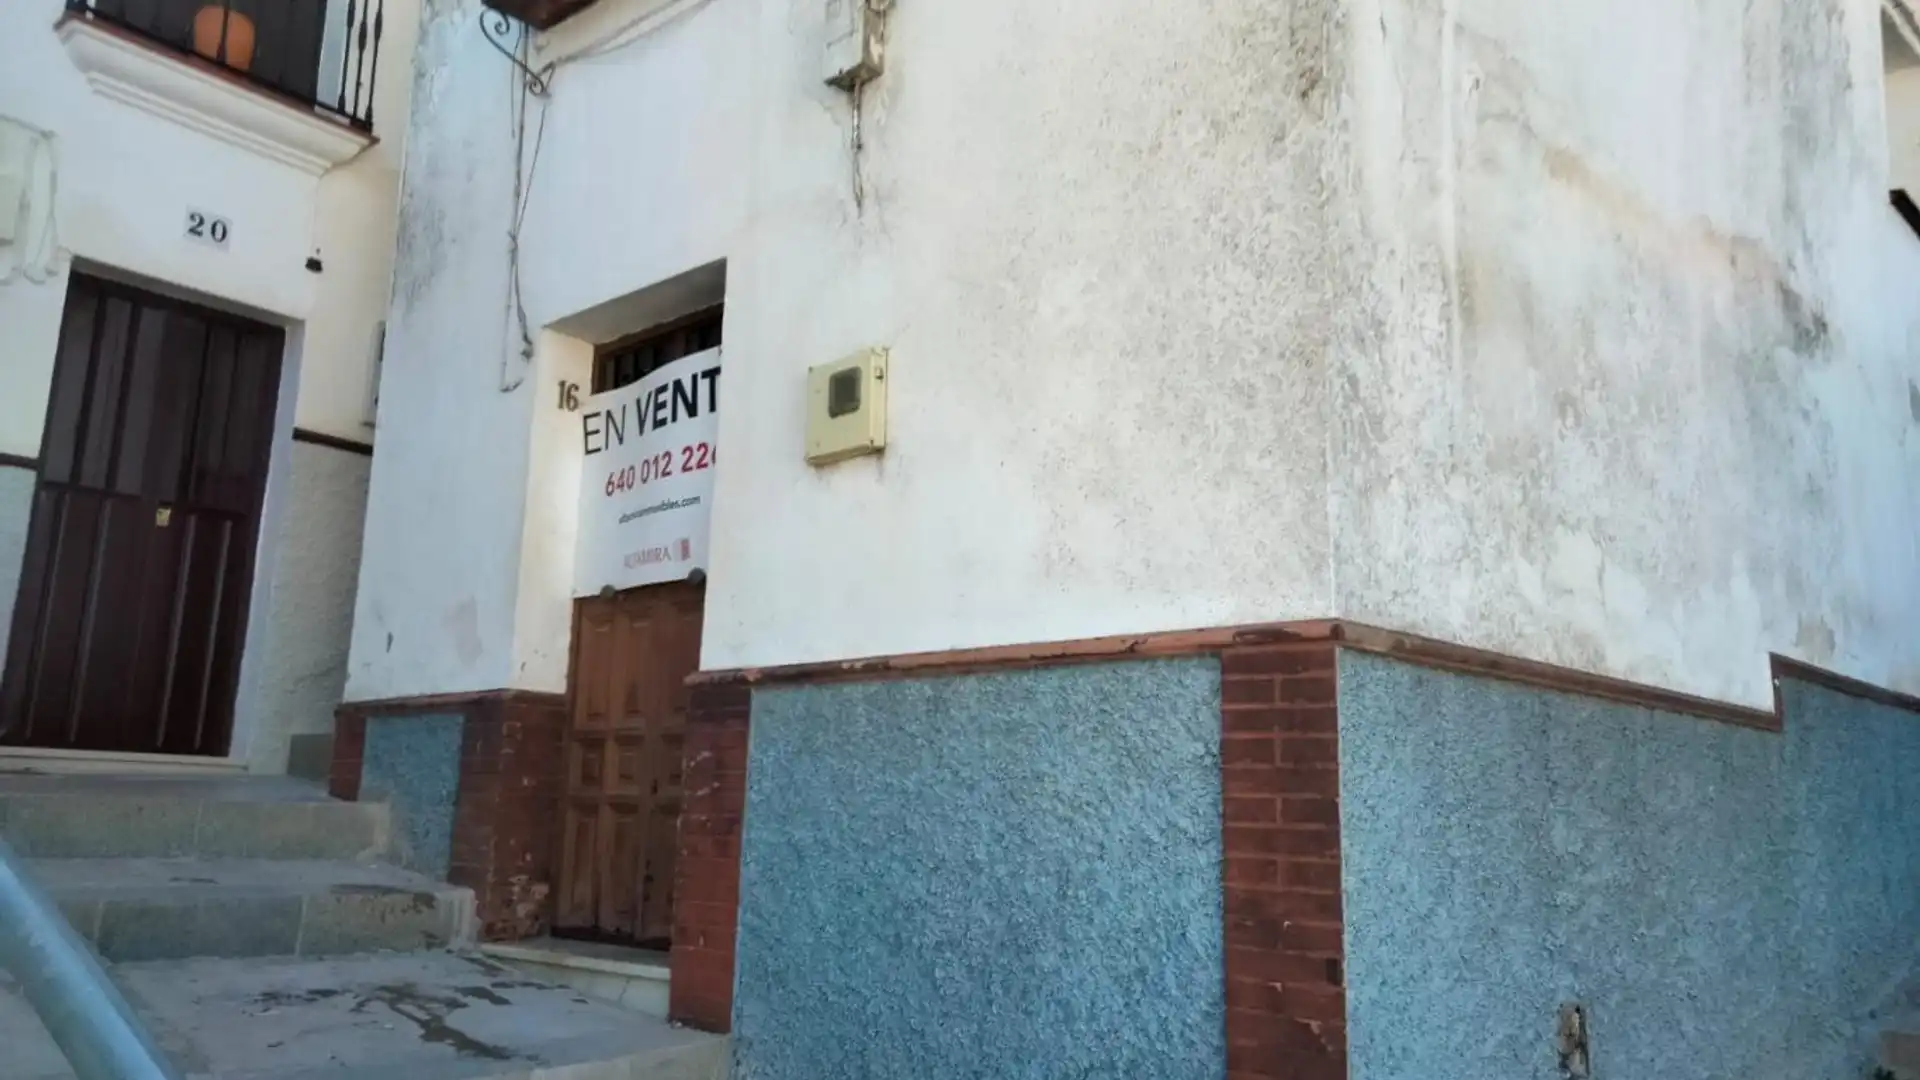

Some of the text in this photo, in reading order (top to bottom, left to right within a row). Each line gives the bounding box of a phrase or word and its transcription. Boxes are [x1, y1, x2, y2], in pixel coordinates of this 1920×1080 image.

[187, 211, 228, 243] 20
[558, 379, 580, 412] 16
[583, 403, 627, 455] EN
[605, 465, 636, 497] 640
[641, 450, 673, 485] 012
